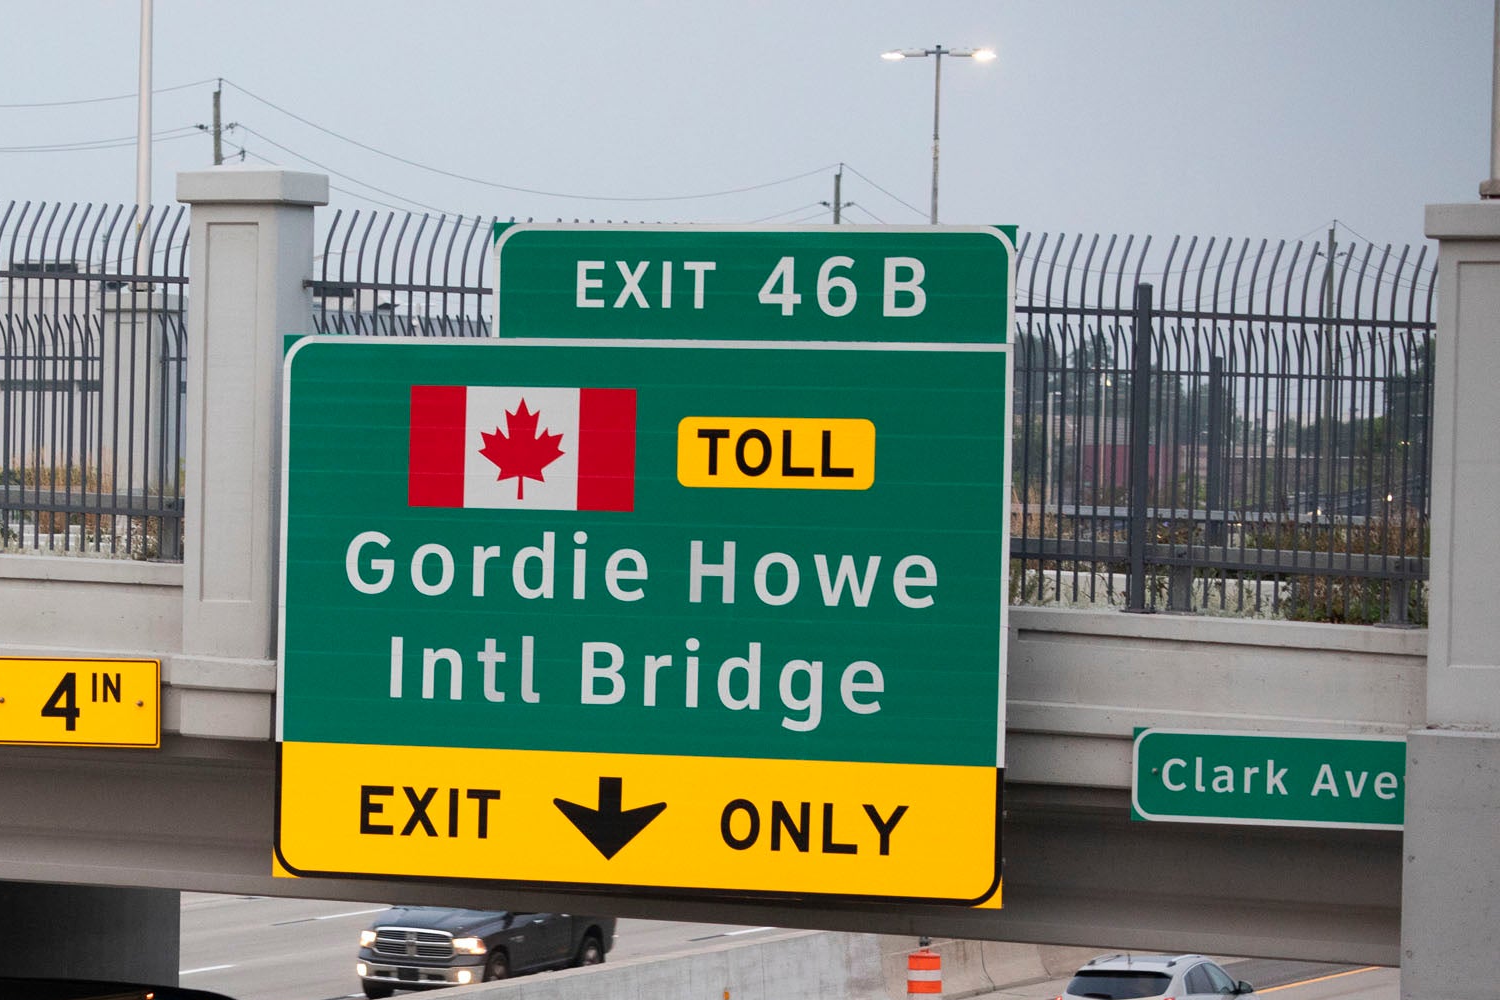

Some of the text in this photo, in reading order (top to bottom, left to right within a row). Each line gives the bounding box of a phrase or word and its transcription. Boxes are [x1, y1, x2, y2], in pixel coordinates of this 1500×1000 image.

[577, 260, 716, 309] EXIT
[698, 429, 854, 478] TOLL
[345, 531, 938, 608] Gordie Howe
[41, 672, 80, 731] 4
[92, 673, 121, 703] IN
[389, 636, 885, 731] Intl Bridge
[1161, 757, 1404, 800] Clark Ave
[360, 784, 909, 856] EXIT ONLY
